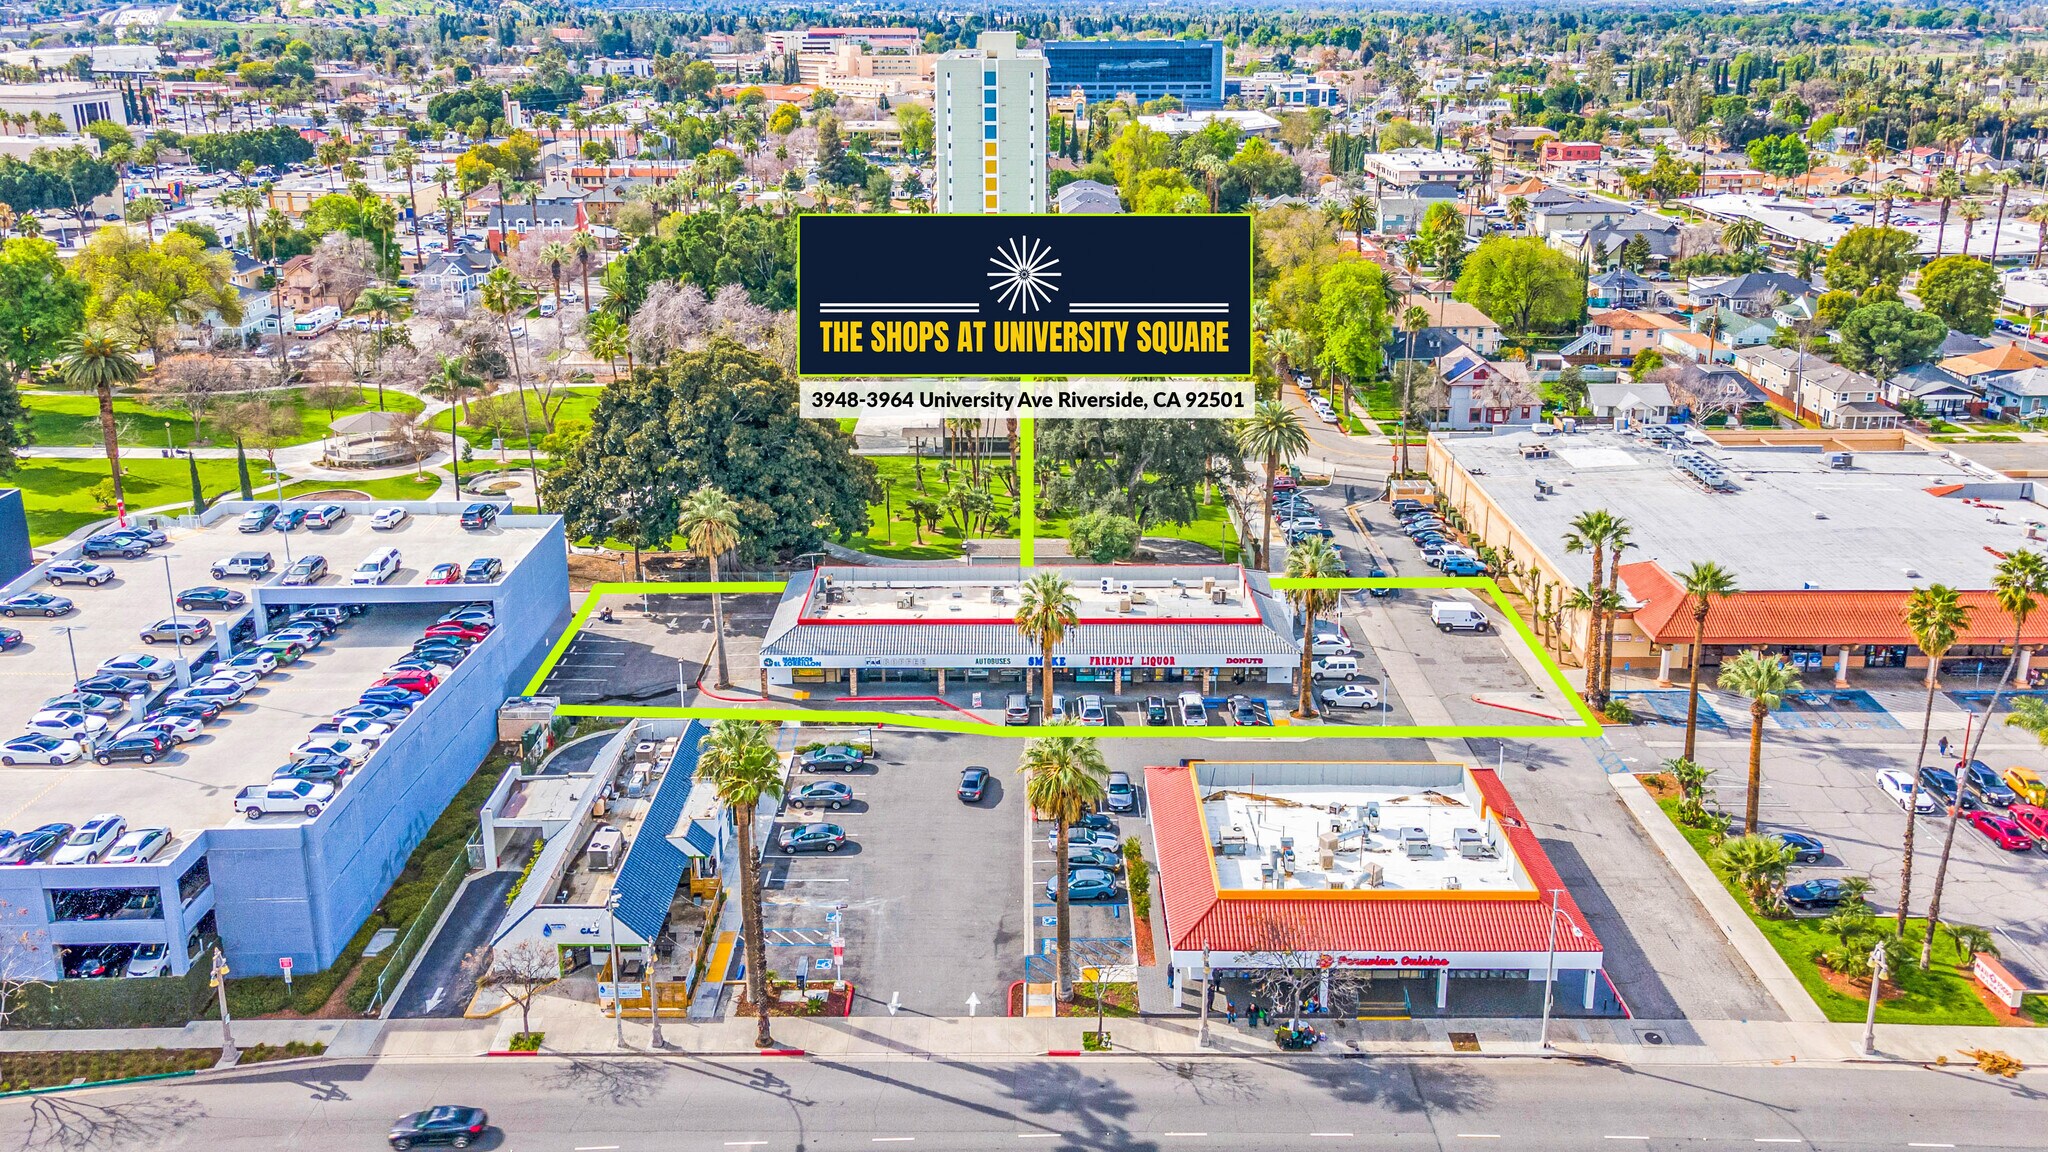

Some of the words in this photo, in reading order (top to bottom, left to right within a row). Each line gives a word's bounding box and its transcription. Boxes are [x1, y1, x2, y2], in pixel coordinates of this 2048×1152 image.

[1028, 656, 1066, 666] SMKE
[1089, 656, 1134, 666] FRIENDLY
[1141, 656, 1175, 667] LIQUOR
[1338, 955, 1398, 966] Peruvian
[1401, 955, 1450, 966] Cuisine
